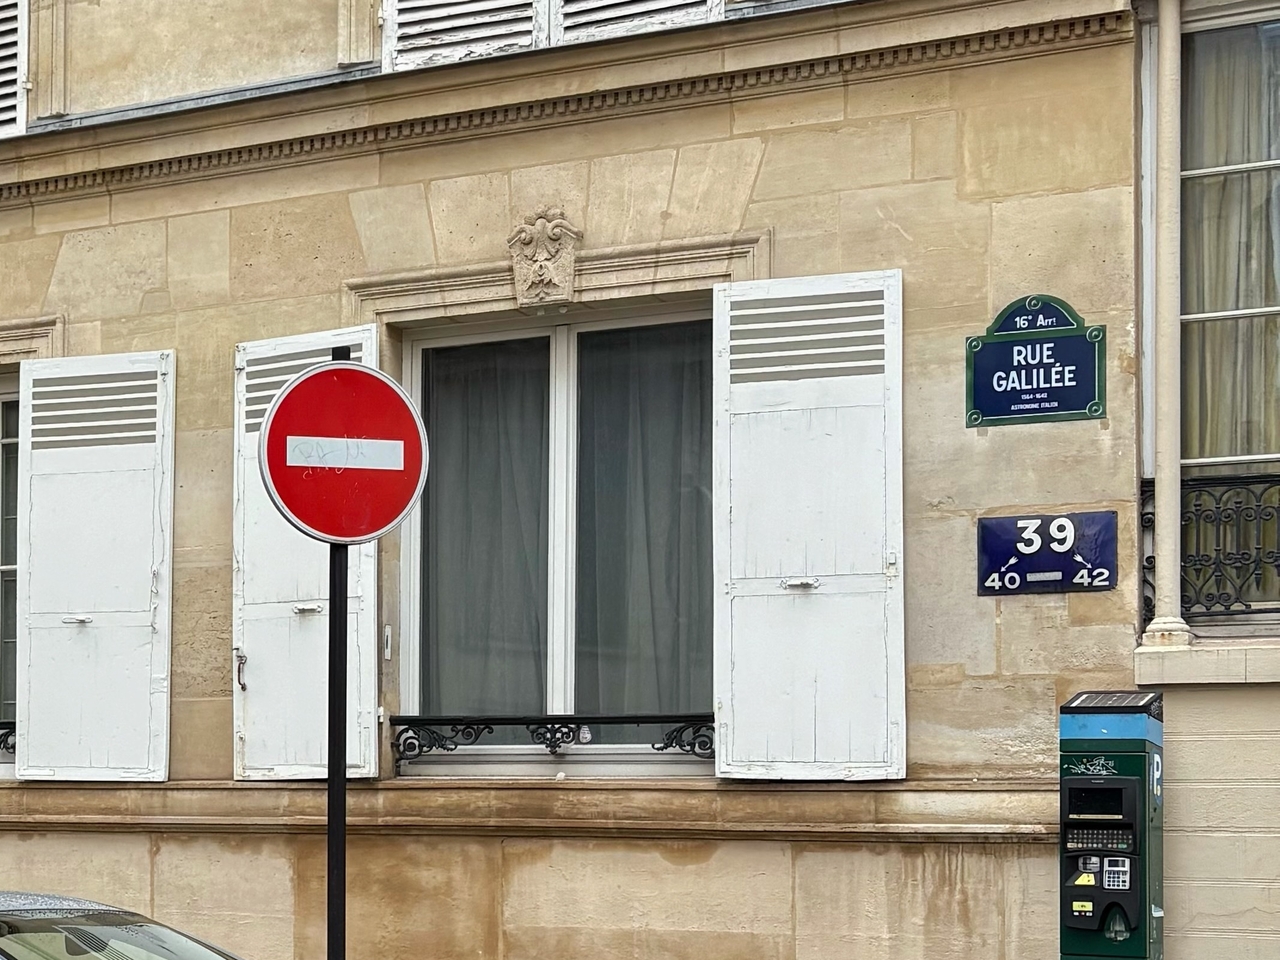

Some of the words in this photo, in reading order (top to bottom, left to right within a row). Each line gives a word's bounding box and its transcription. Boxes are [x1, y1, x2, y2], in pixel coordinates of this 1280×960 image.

[1013, 343, 1055, 366] RUE
[993, 363, 1076, 392] GALILÉE
[1016, 518, 1075, 554] 39
[984, 573, 1020, 590] 40
[1072, 568, 1110, 587] 42
